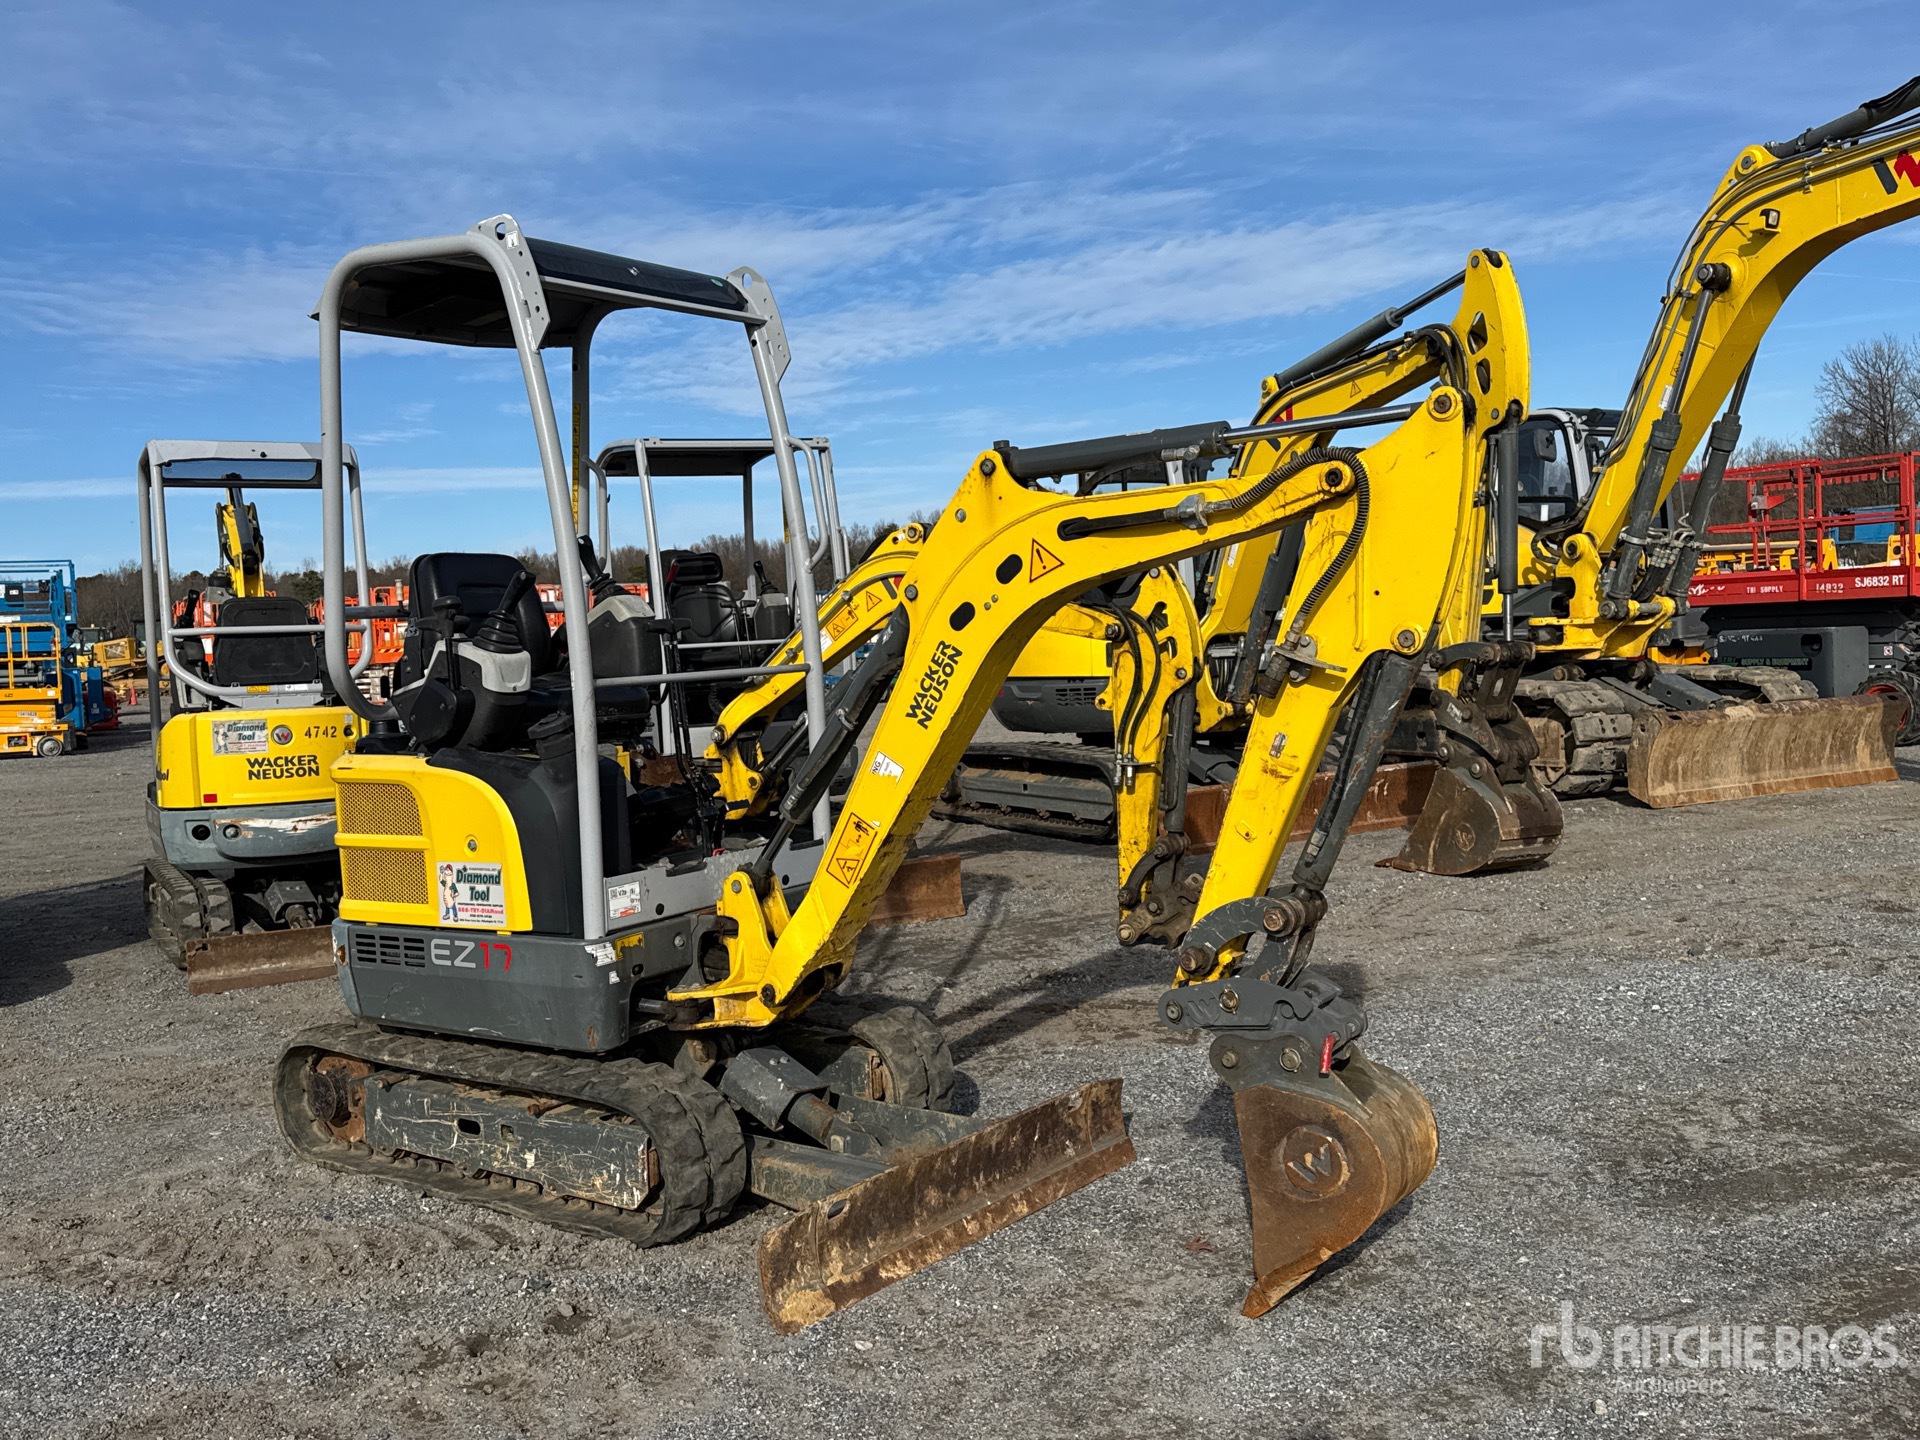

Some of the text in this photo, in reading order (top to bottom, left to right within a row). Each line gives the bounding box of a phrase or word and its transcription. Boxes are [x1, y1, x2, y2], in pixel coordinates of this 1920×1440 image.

[1854, 575, 1905, 588] SJ6832 RT
[1760, 585, 1784, 593] SUPPLY
[904, 640, 952, 719] WACKER
[917, 645, 963, 730] NEUSON
[227, 722, 266, 733] Diamond
[304, 726, 337, 738] 4742
[237, 732, 256, 741] Tool
[246, 754, 319, 769] WACKER
[248, 766, 320, 780] NEUSON
[456, 868, 502, 885] Diamond
[469, 886, 490, 902] Tool
[430, 938, 513, 971] EZ17
